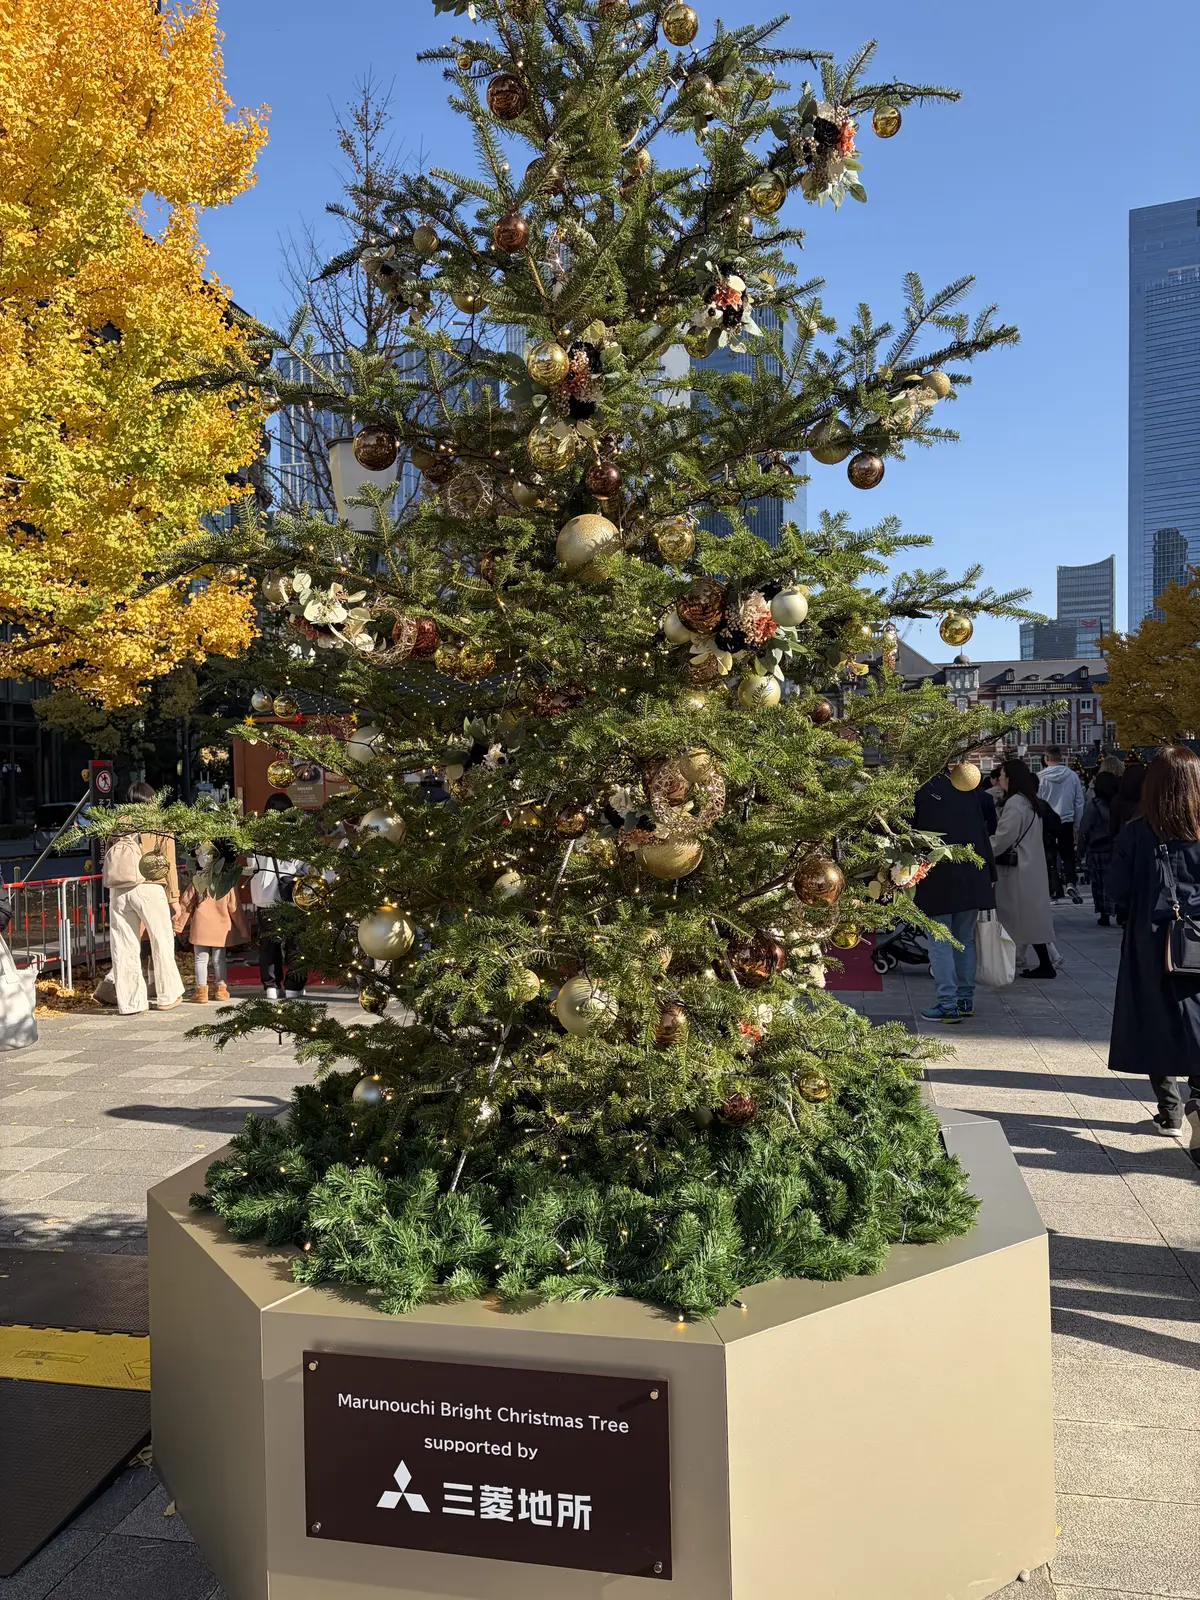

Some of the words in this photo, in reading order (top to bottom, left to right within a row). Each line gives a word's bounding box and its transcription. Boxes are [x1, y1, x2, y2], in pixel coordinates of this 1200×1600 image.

[338, 1393, 436, 1416] Marunouchi
[440, 1401, 493, 1421] Bright
[497, 1407, 584, 1429] Christmas
[588, 1415, 630, 1434] Tree
[424, 1436, 513, 1457] supported
[517, 1442, 539, 1460] by
[441, 1482, 593, 1531] 三菱地所
